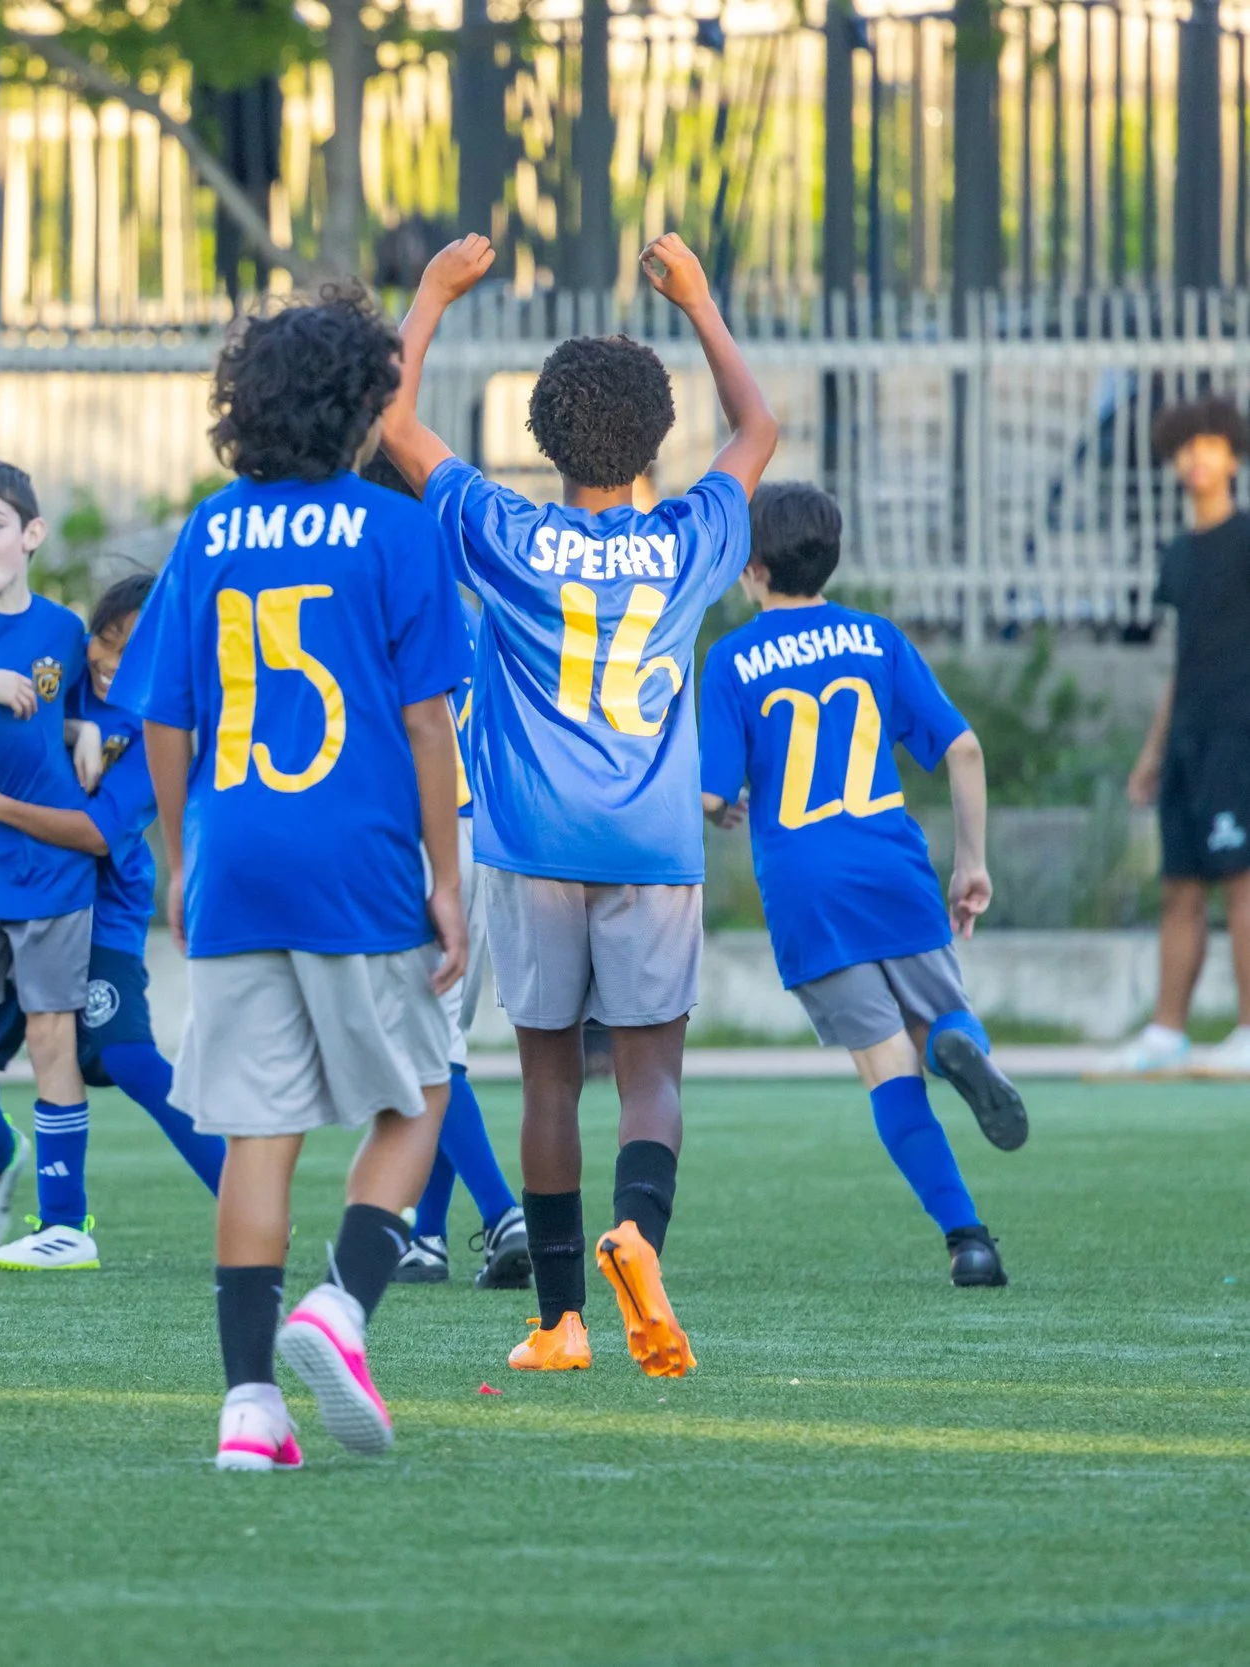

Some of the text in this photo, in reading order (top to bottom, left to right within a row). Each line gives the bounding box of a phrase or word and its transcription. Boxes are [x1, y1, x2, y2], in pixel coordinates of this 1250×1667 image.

[205, 503, 367, 557] SIMON
[530, 526, 676, 580] SPERRY
[214, 584, 346, 793] 15
[557, 582, 683, 737] 16
[734, 623, 883, 684] MARSHALL
[761, 676, 904, 830] 22
